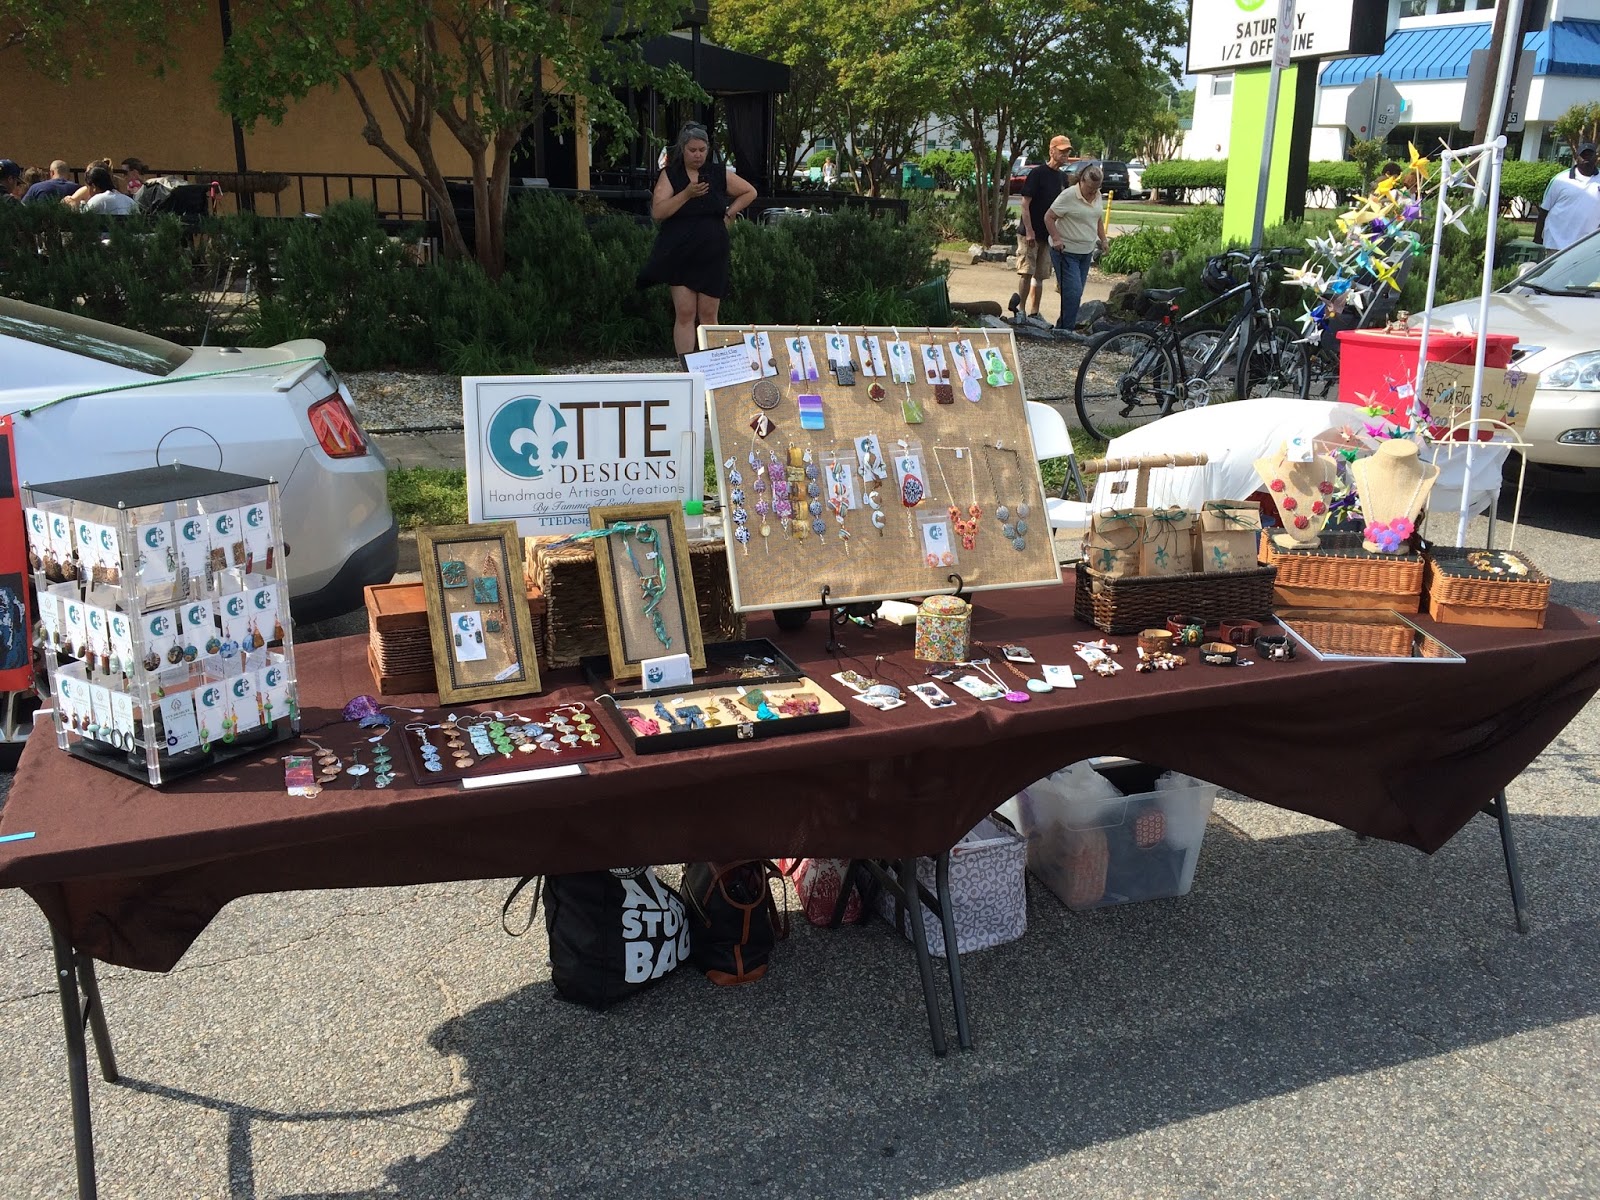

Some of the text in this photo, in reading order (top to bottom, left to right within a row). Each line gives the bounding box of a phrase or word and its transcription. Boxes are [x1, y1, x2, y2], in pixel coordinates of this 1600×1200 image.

[1236, 13, 1306, 39] SATURY
[1222, 43, 1242, 61] 1/2
[1250, 38, 1274, 57] OFF
[559, 400, 671, 460] TTE
[560, 461, 677, 484] DESIGNS
[489, 483, 685, 502] Handmade Artisan Creations
[533, 502, 549, 514] By
[625, 918, 691, 983] BAG
